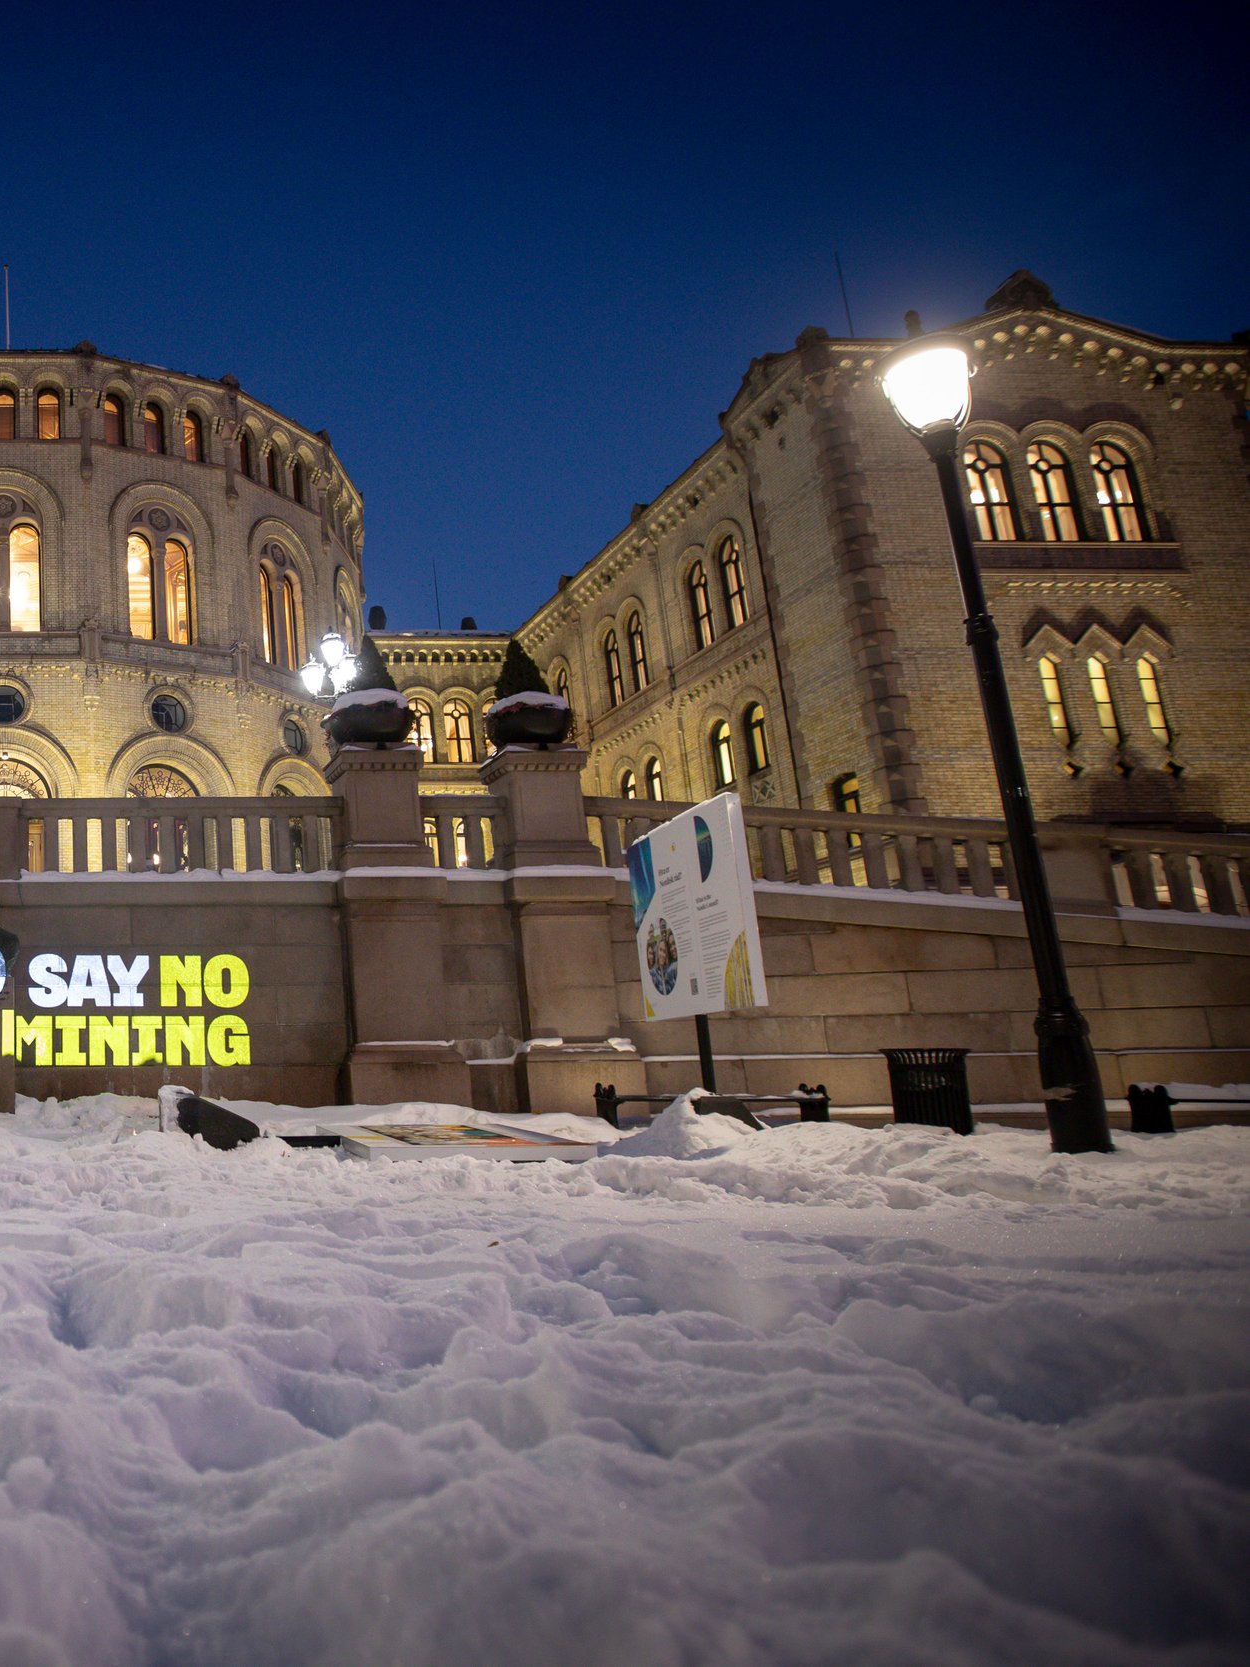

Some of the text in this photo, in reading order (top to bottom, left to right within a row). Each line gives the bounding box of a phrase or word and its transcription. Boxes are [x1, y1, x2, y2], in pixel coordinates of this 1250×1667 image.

[28, 954, 150, 1008] SAY
[160, 954, 250, 1008] NO
[2, 1009, 250, 1067] MINING
